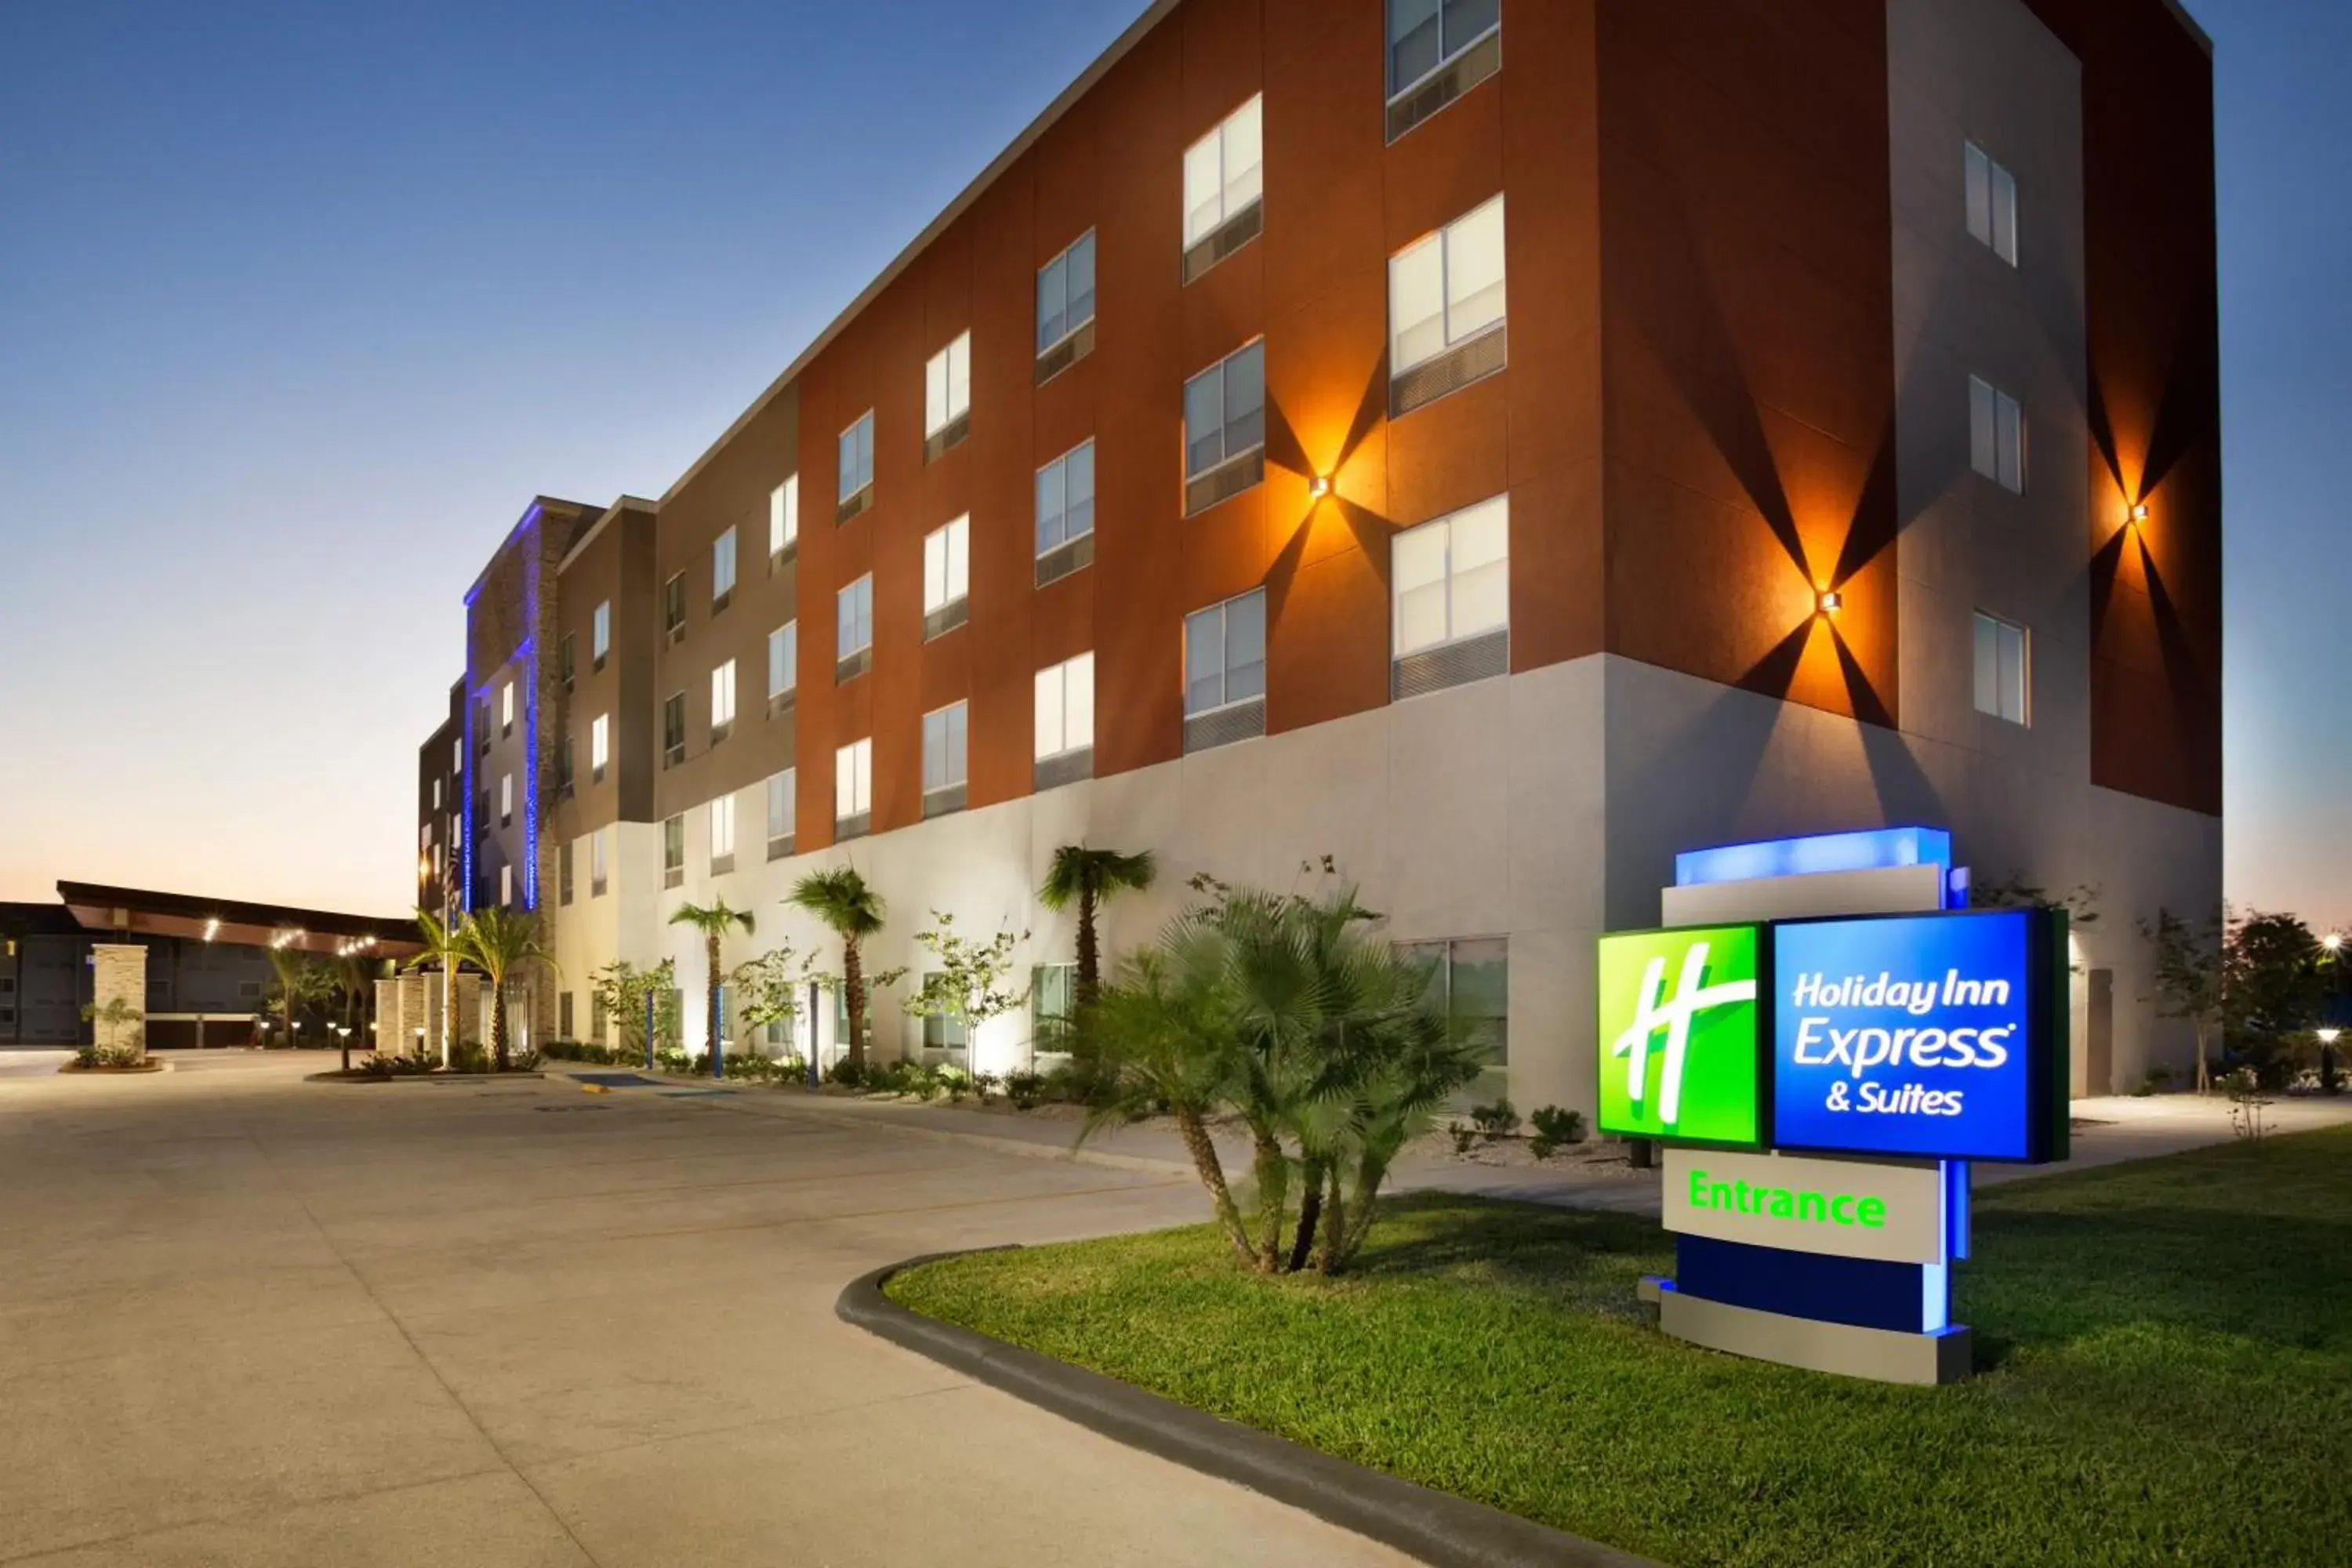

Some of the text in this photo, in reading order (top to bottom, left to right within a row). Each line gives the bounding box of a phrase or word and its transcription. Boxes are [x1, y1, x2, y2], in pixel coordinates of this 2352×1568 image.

[1793, 969, 2009, 1014] Holiday Inn
[1794, 1017, 2011, 1079] Express
[1826, 1081, 1963, 1116] & Suites
[1689, 1170, 1886, 1229] Entrance
